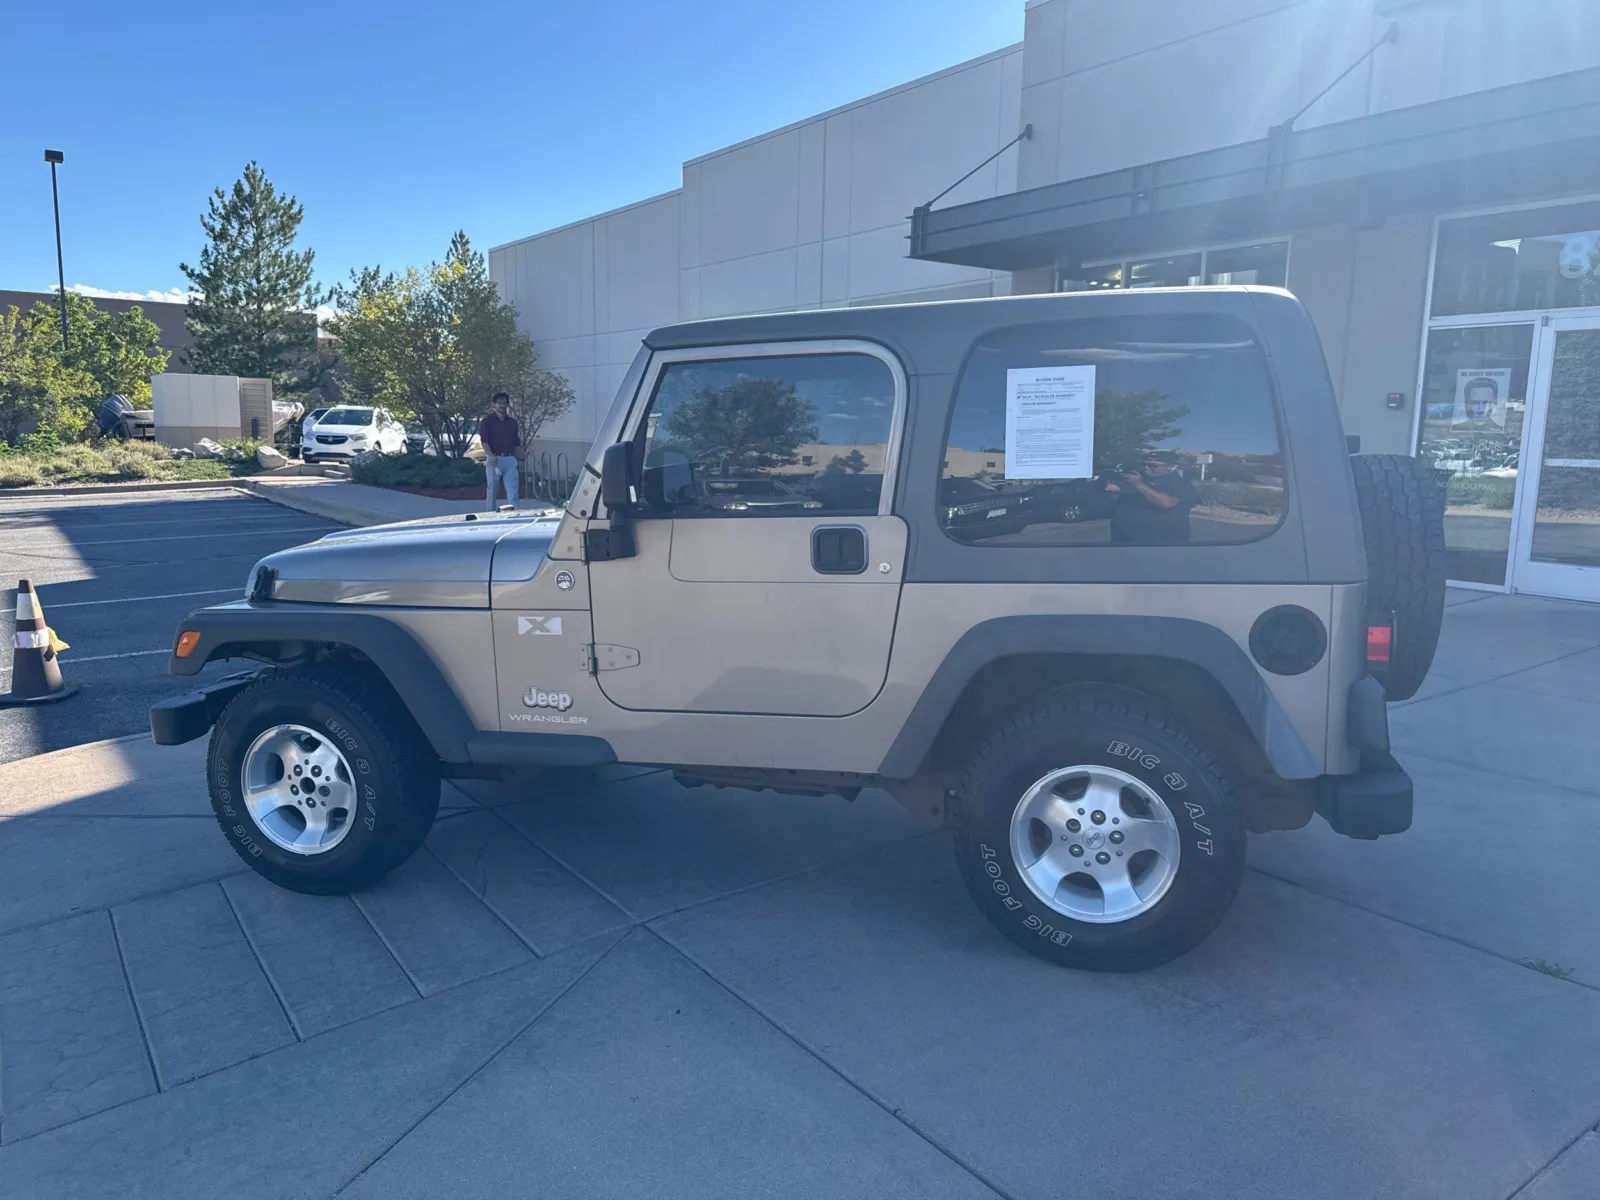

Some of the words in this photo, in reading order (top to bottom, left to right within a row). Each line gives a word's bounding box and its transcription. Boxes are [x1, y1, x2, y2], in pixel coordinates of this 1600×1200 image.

[509, 714, 588, 724] WRANGLER
[523, 687, 573, 711] Jeep
[217, 758, 236, 816] FOOT
[324, 718, 358, 751] BIG
[363, 784, 377, 831] A/T
[1107, 740, 1160, 769] BIG
[1184, 801, 1213, 855] A/T
[232, 824, 264, 858] BIG
[981, 844, 1022, 911] FOOT
[1023, 915, 1073, 947] BIG
